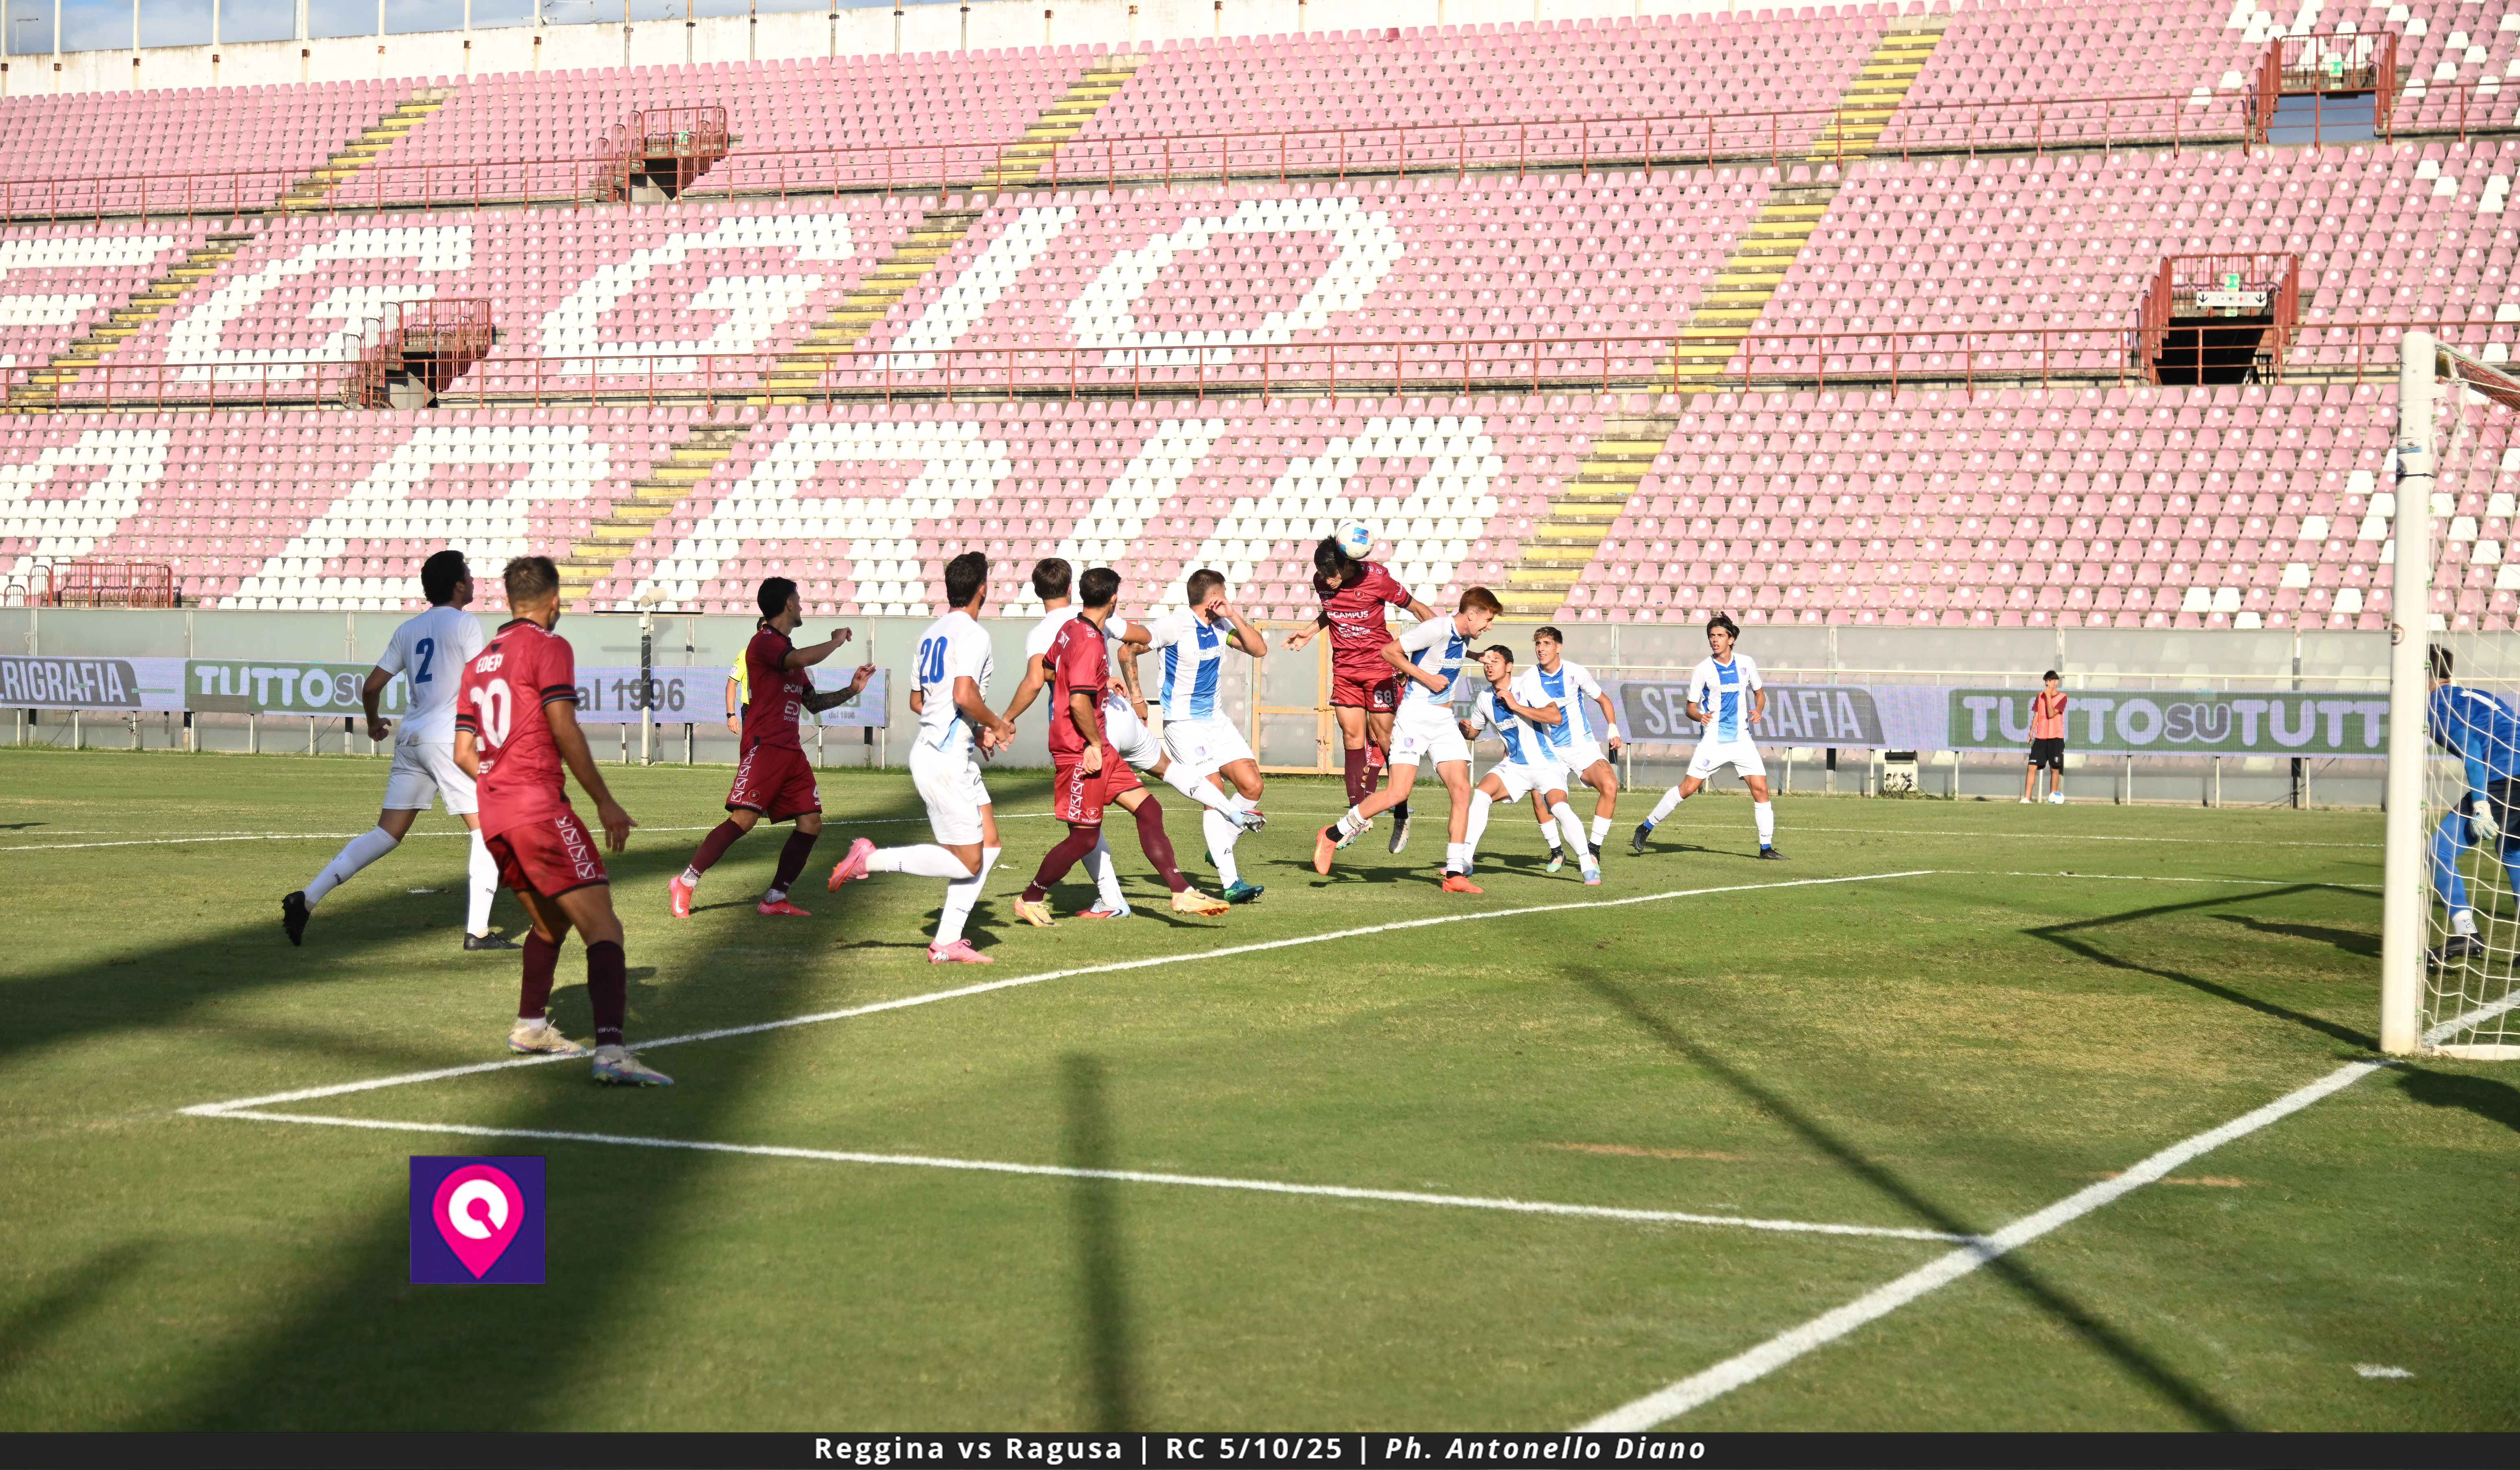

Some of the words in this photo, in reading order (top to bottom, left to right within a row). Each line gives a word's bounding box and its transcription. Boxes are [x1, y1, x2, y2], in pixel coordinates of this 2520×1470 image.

[1341, 629, 1371, 638] DECORATION
[415, 637, 435, 684] 2
[920, 636, 948, 684] 20
[0, 661, 127, 702] RIGRAFIA
[611, 678, 685, 712] 1996
[1374, 690, 1392, 704] 68
[742, 801, 763, 810] PULISERVICE
